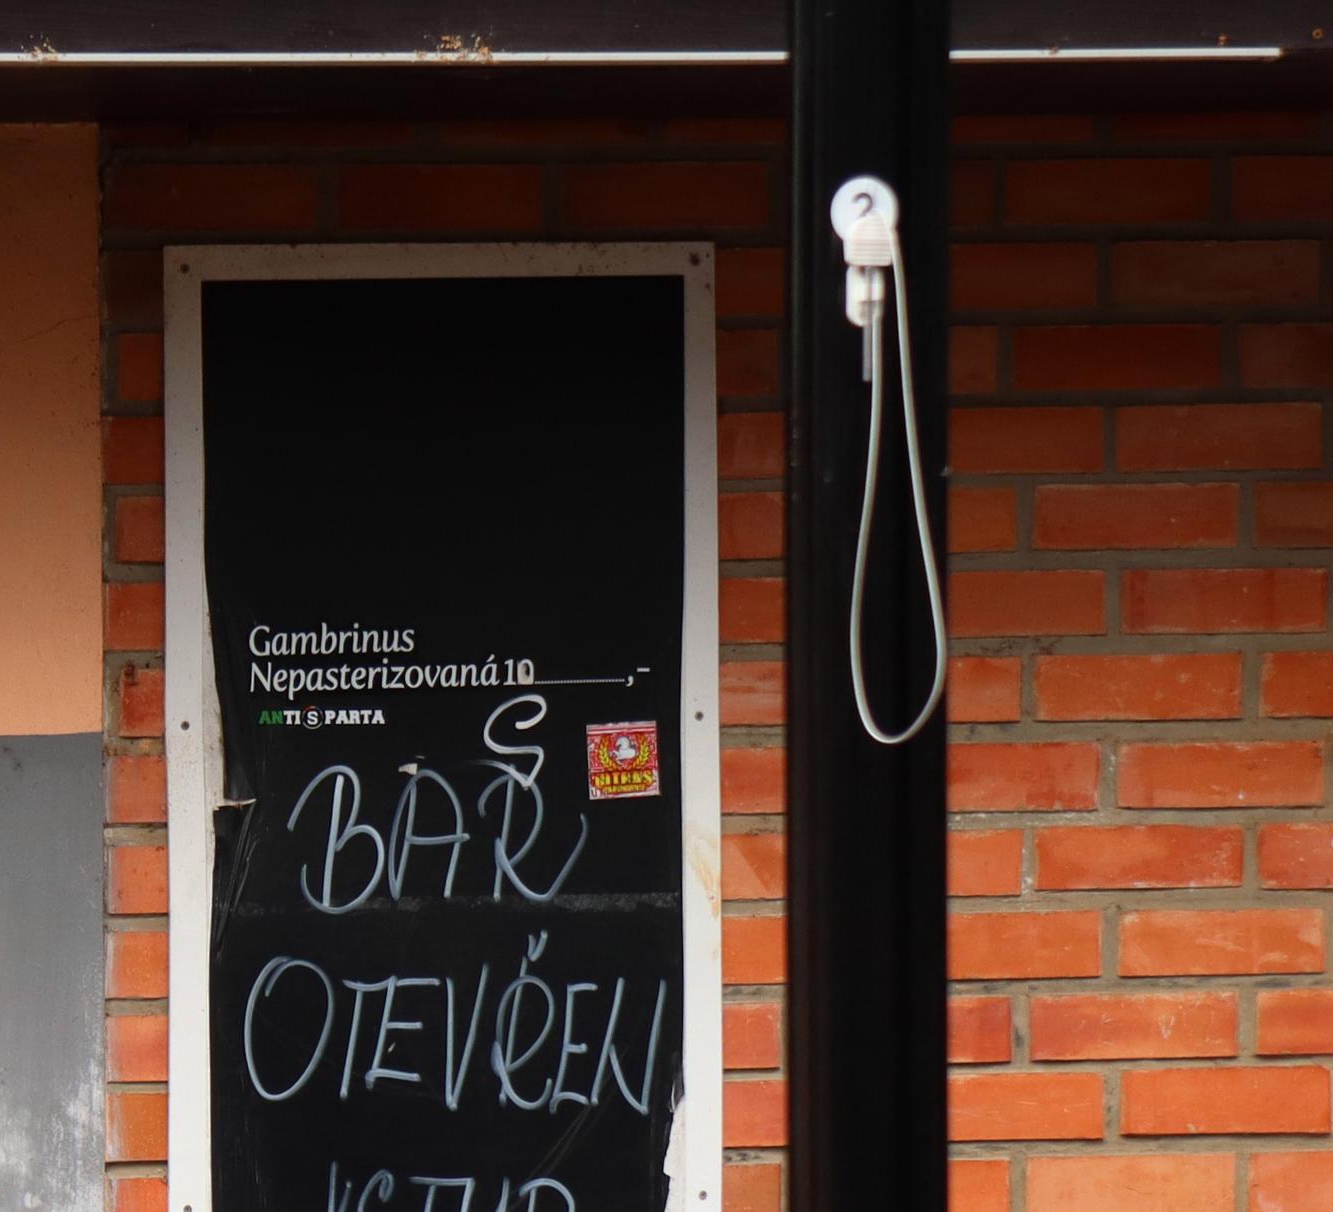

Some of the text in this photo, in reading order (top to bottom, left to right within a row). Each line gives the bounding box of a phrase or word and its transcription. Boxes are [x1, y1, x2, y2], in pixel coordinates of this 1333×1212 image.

[249, 622, 415, 658] Gambrinus
[250, 654, 499, 701] Nepasterizovaná
[244, 930, 667, 1115] OTEVŘEN
